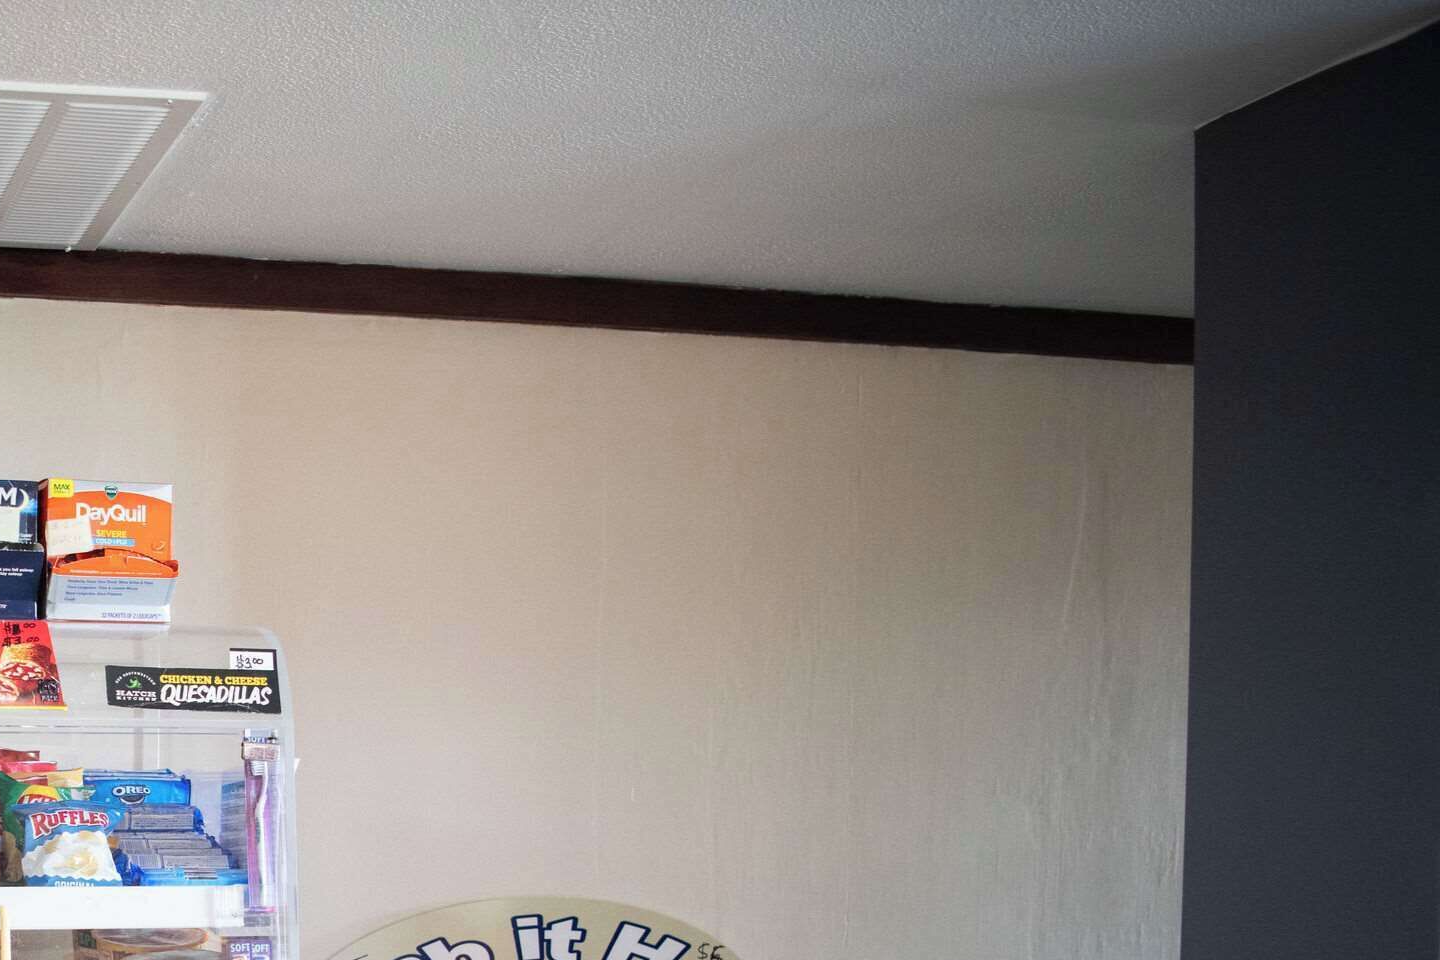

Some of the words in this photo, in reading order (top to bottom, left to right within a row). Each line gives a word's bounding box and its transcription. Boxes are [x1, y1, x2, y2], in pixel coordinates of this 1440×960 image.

[75, 502, 147, 526] DayQuil
[96, 529, 127, 538] SEVERE
[160, 675, 212, 685] CHICKEN
[215, 677, 223, 685] &
[224, 677, 268, 686] CHEESE
[116, 689, 157, 697] HATCH
[160, 683, 273, 706] QUESADILLAS
[112, 785, 151, 797] OREO
[31, 809, 109, 840] RUFFLES
[230, 943, 250, 952] SOFT
